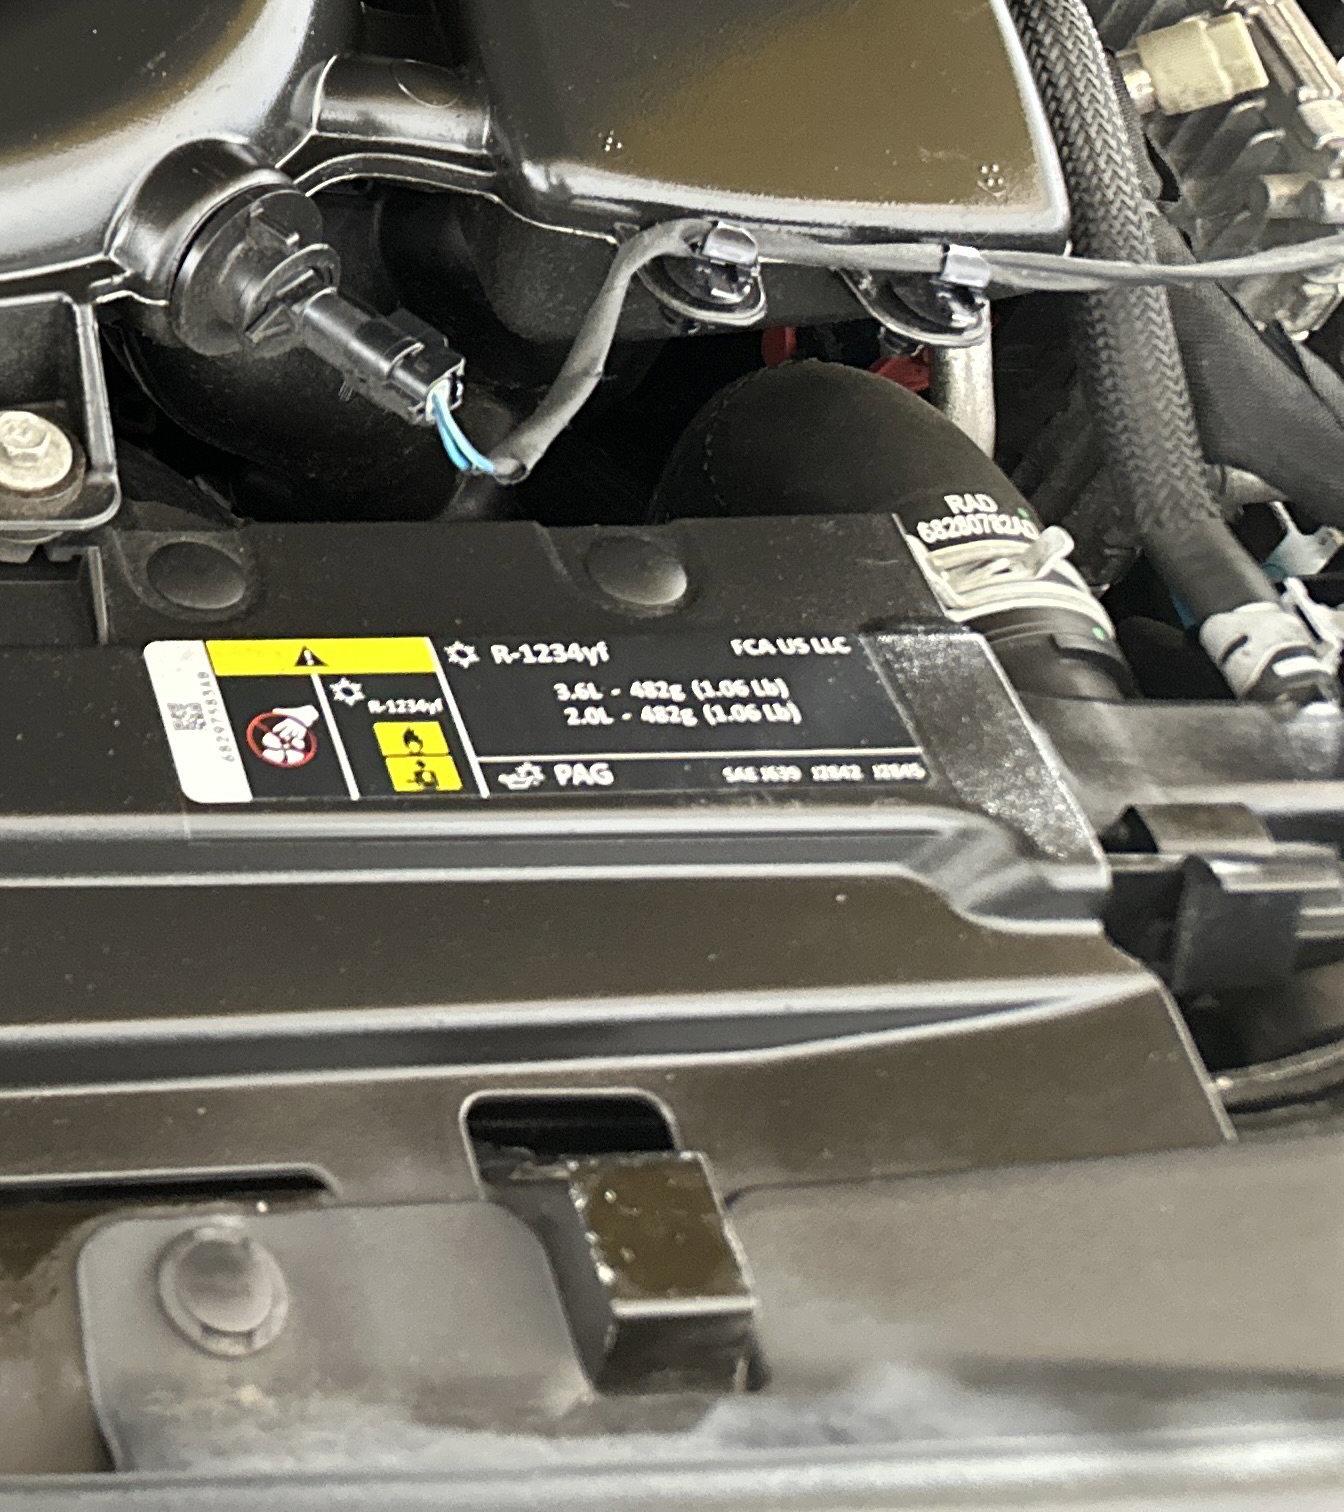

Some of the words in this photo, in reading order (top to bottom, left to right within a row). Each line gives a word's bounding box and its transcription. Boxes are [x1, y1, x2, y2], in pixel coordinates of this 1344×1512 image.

[944, 493, 999, 514] RAD
[490, 641, 610, 667] R-1234yf
[730, 639, 777, 656] FCA
[776, 637, 811, 655] US
[810, 636, 853, 655] LLC
[553, 682, 604, 702] 3.6L
[563, 706, 615, 726] 2.0L
[553, 762, 615, 786] PAG
